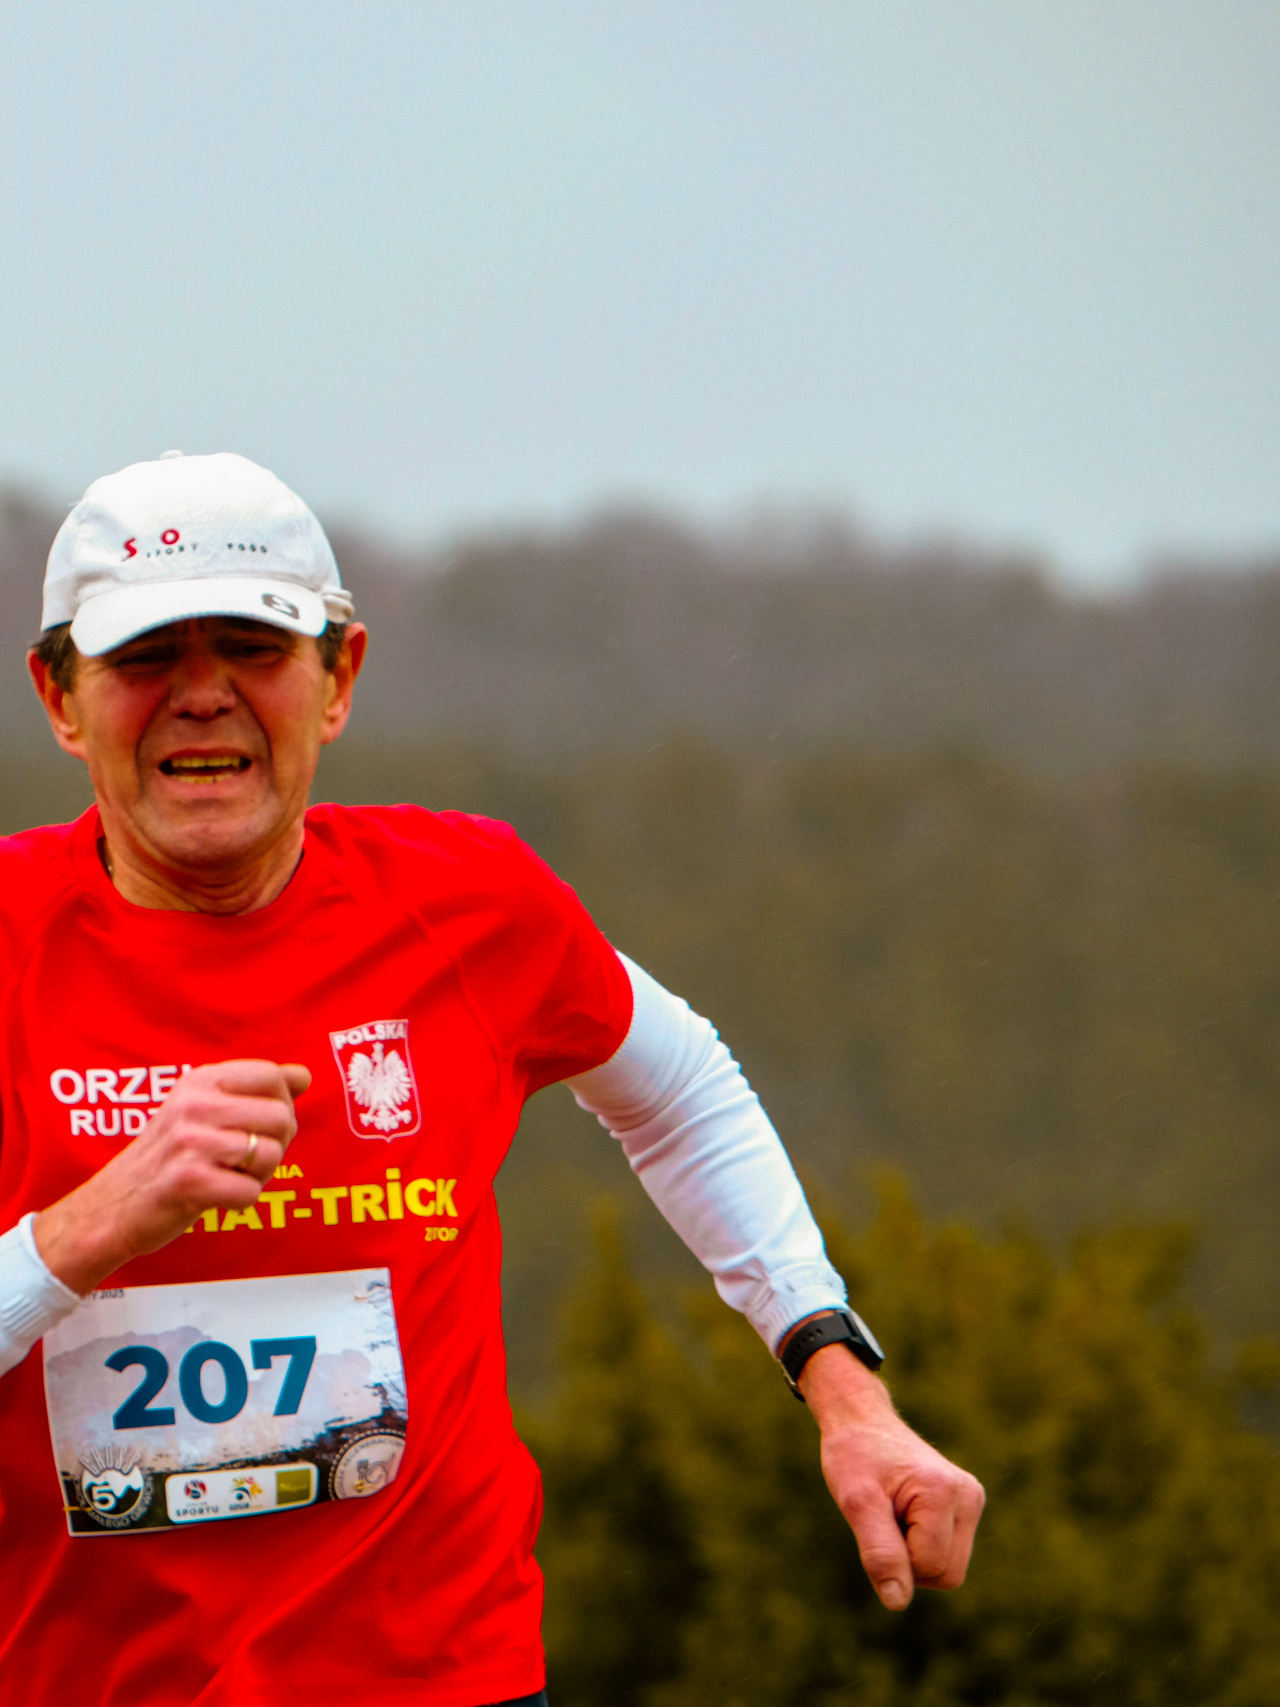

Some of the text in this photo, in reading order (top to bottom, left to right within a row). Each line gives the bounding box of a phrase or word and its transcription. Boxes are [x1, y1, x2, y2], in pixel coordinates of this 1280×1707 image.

[333, 1022, 407, 1051] POLSKA
[49, 1063, 191, 1105] ORZE
[69, 1107, 158, 1137] RUD
[104, 1334, 318, 1431] 207
[91, 1484, 118, 1512] 5
[175, 1504, 219, 1517] SPORTU
